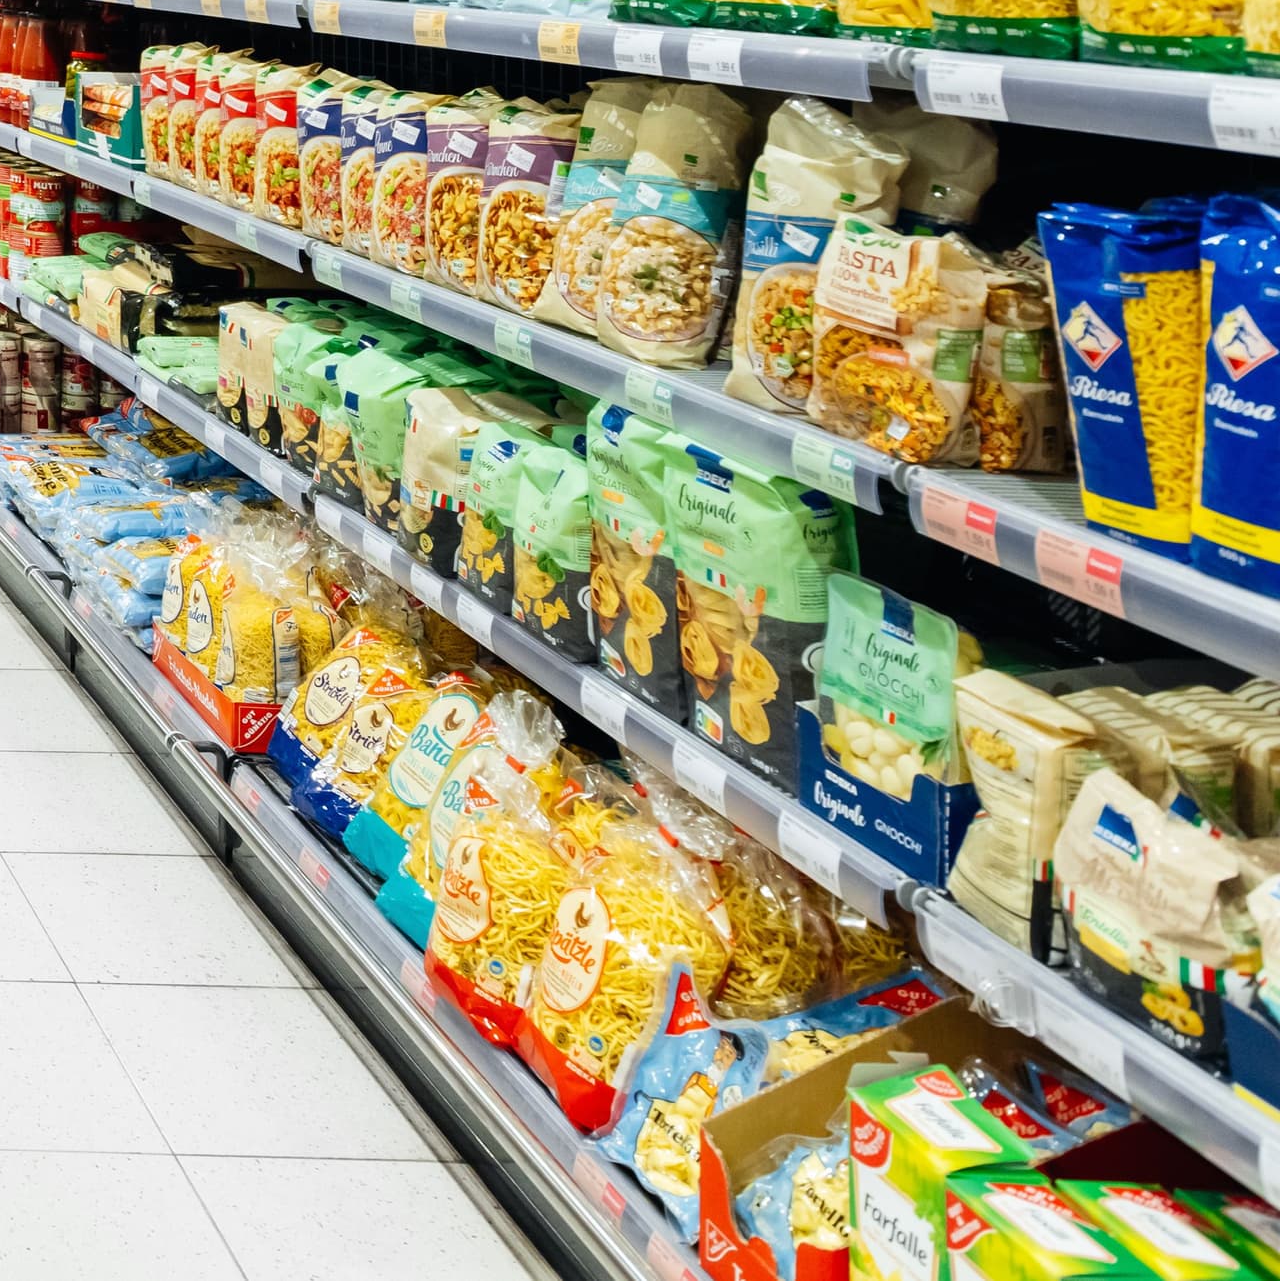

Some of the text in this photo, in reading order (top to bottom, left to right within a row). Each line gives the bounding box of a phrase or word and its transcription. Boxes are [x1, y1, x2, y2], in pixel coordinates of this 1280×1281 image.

[838, 246, 897, 279] PASTA
[1070, 374, 1132, 406] Riesa
[1207, 387, 1276, 422] Riesa
[696, 468, 734, 492] EDEKA
[678, 485, 737, 524] Originale
[864, 633, 919, 674] Originale
[858, 662, 926, 707] GNOCCHI
[814, 783, 867, 830] Originale
[874, 819, 923, 856] GNOCCHI
[864, 1191, 928, 1268] Farfalle
